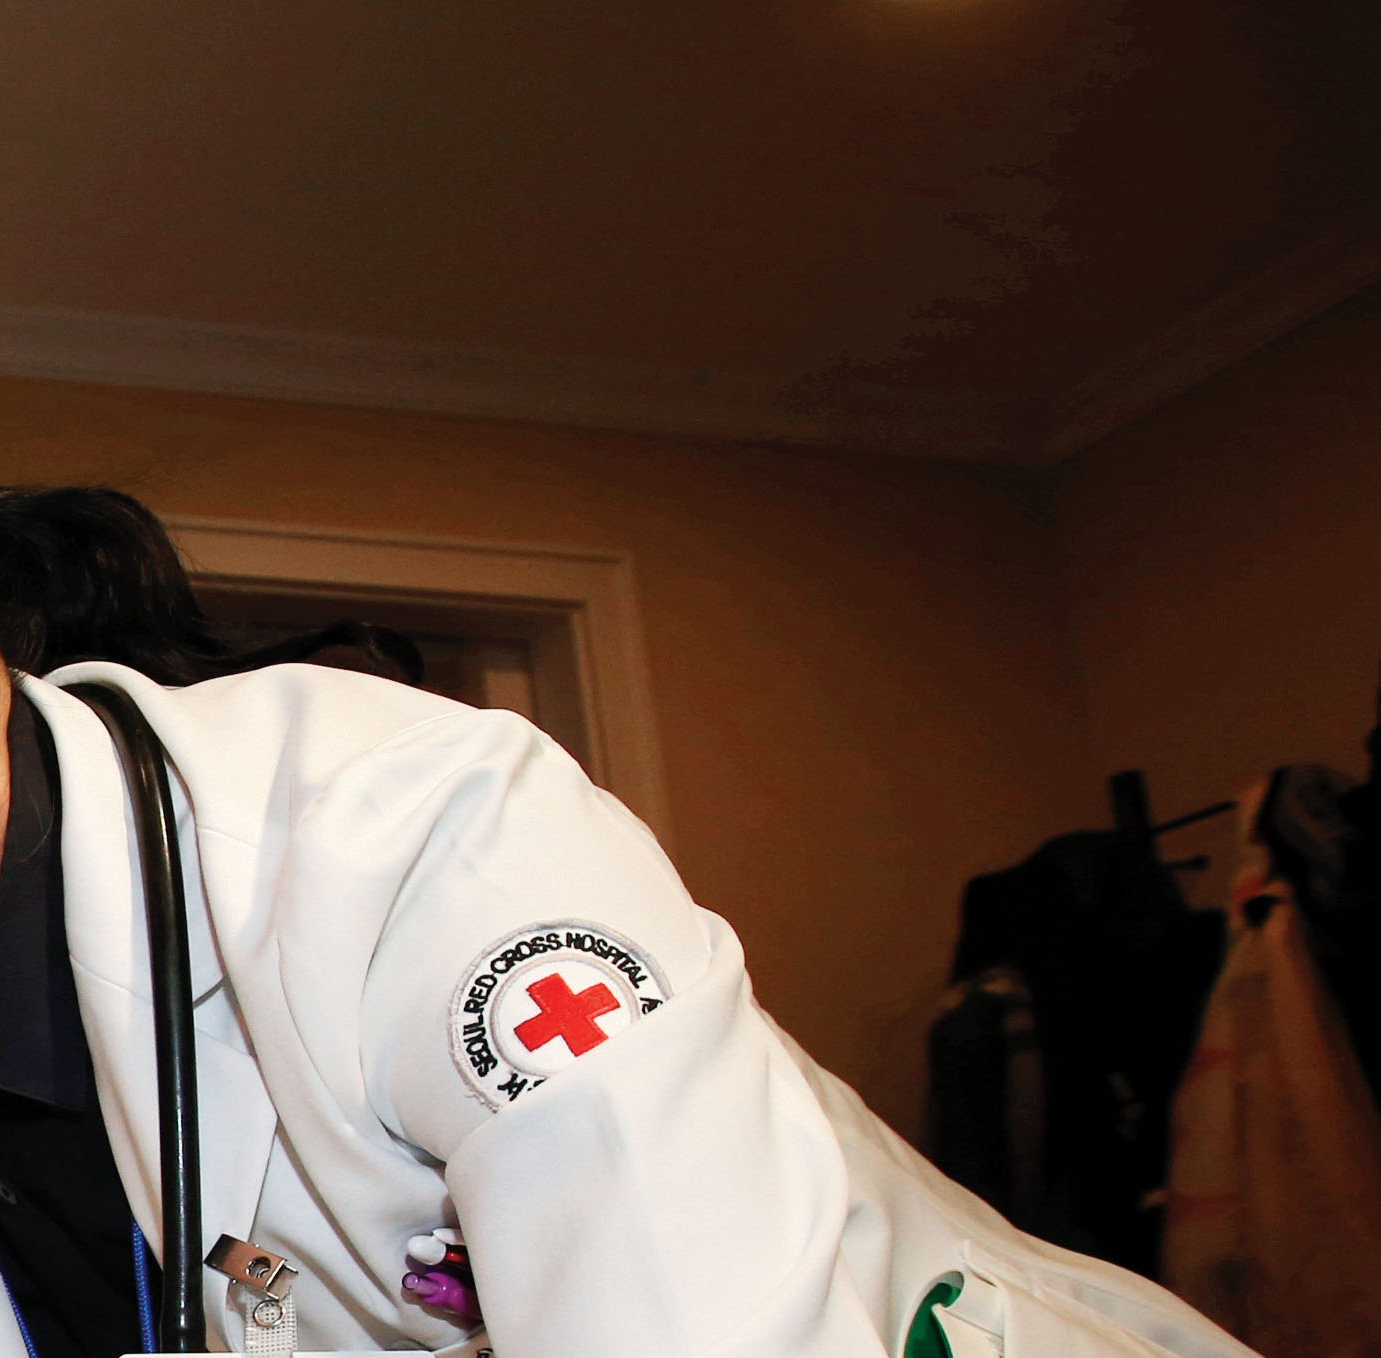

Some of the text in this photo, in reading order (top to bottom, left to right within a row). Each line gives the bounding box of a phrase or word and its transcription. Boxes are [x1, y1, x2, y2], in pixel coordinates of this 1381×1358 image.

[490, 933, 562, 974] CROSS
[566, 932, 648, 989] HOSPITAL
[464, 974, 498, 1014] RED
[463, 1013, 498, 1077] SEOUL
